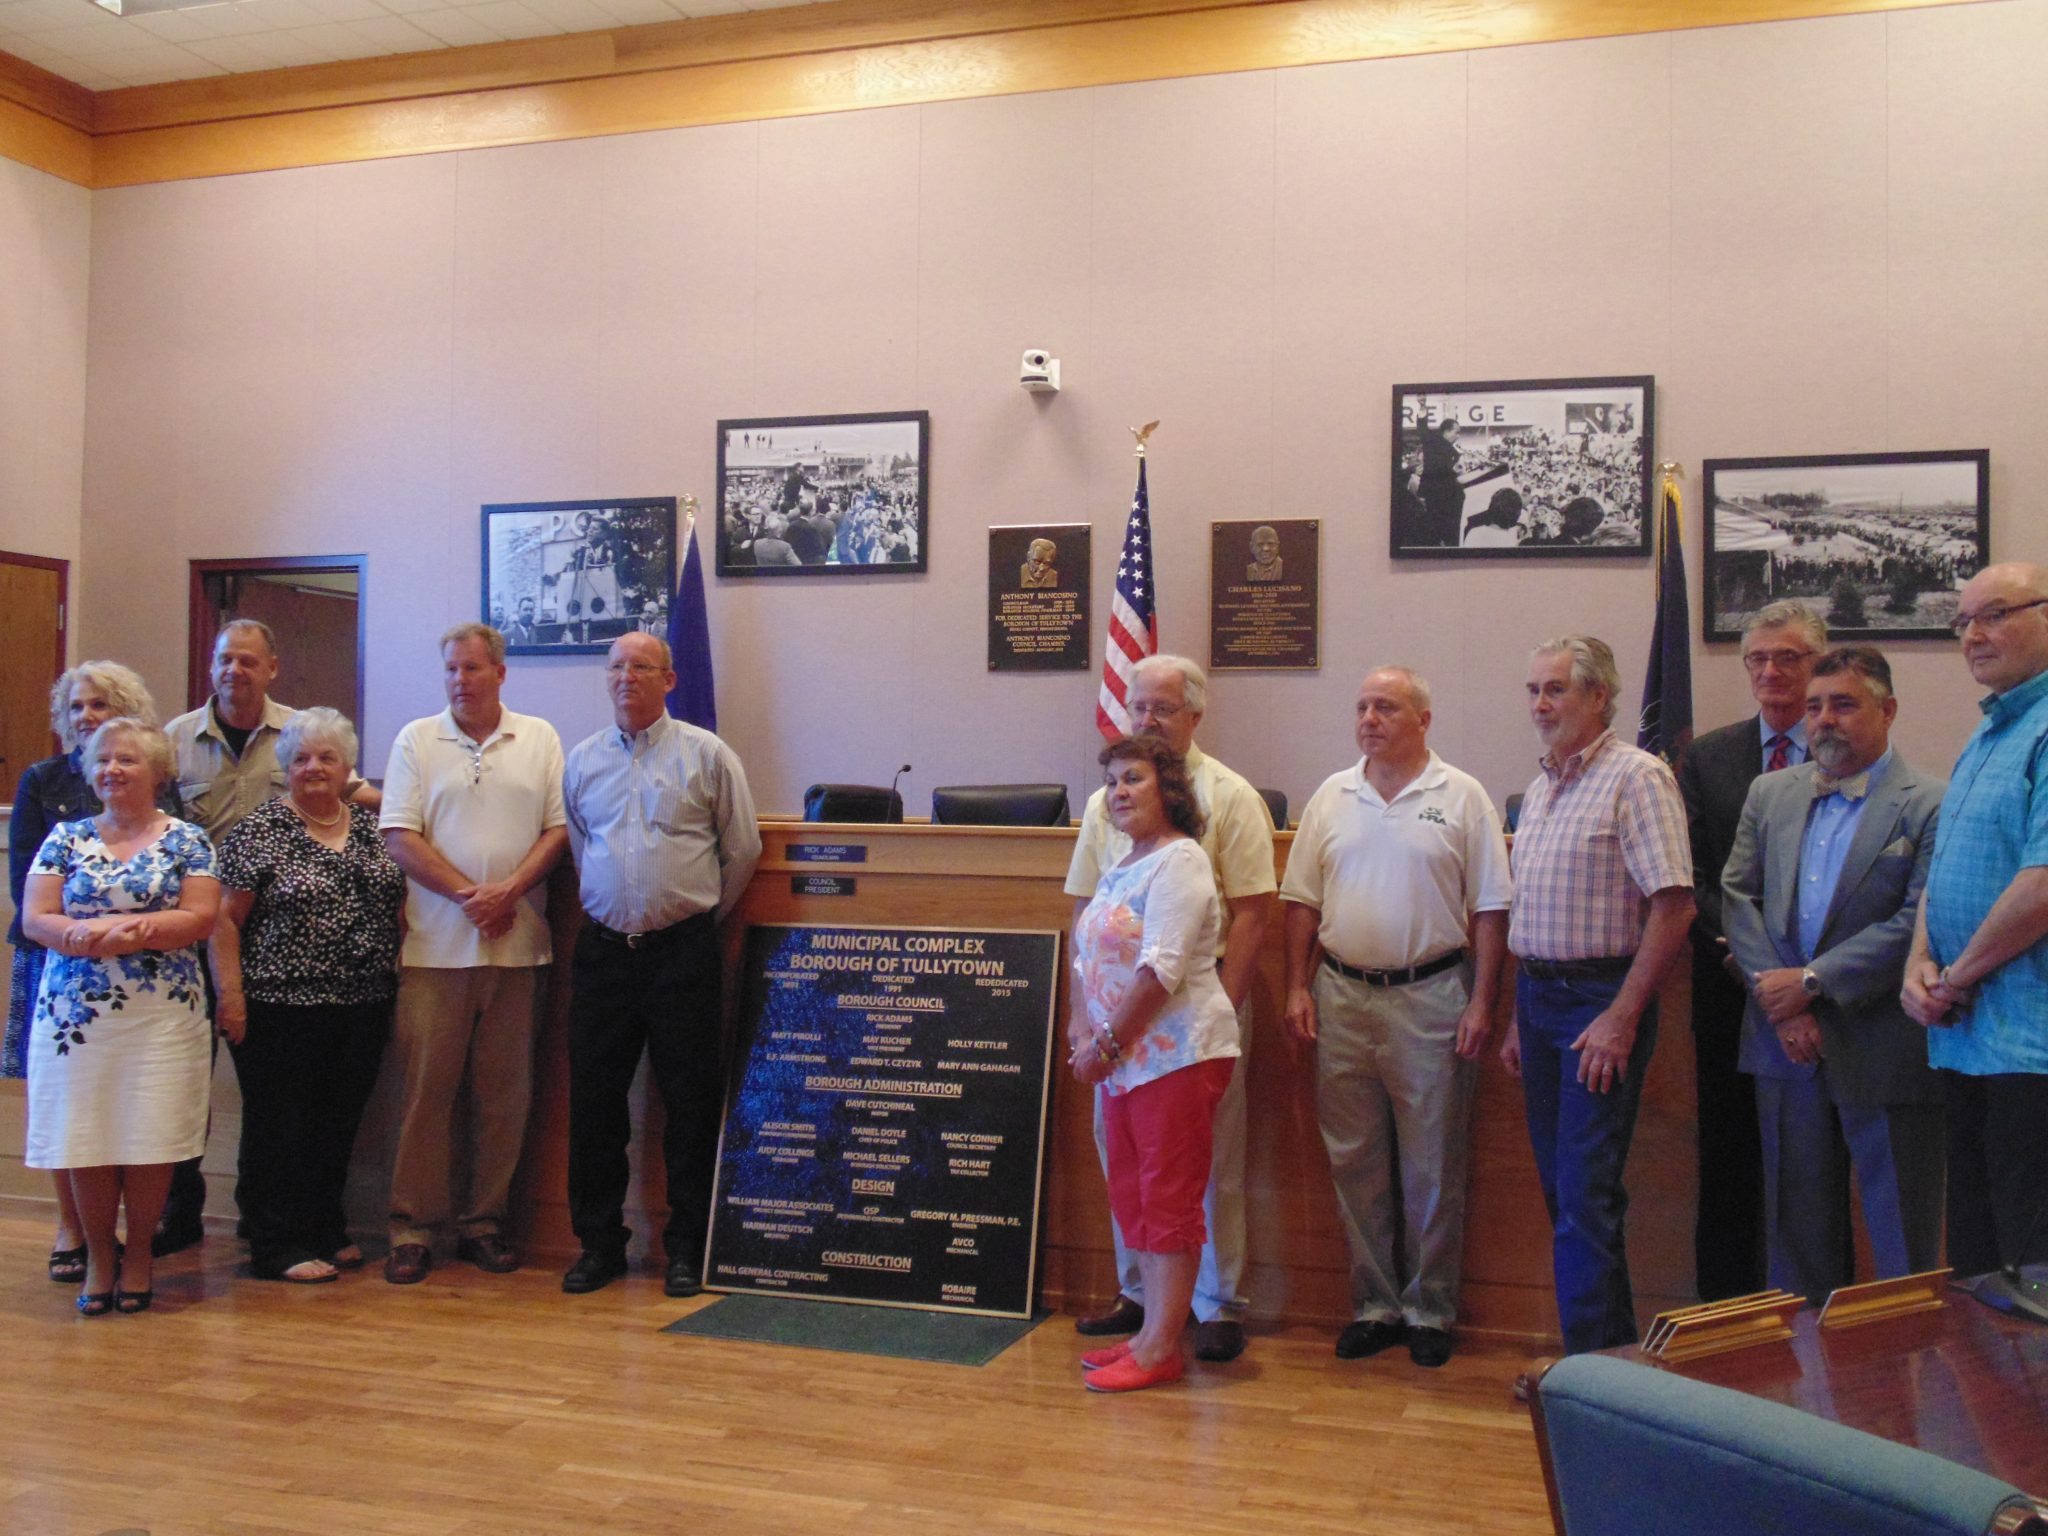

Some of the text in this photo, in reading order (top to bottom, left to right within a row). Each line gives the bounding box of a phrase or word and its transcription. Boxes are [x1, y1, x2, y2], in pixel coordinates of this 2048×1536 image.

[809, 878, 836, 886] COUNCIL
[805, 886, 840, 894] PRESIDENT
[811, 934, 985, 954] MUNICIPAL COMPLEX
[790, 954, 1005, 976] BOROUGH OF TULLYTOWN
[872, 975, 915, 984] DEDICATED
[975, 978, 1029, 988] REDEDICATED
[991, 989, 1011, 997] 2015
[837, 994, 946, 1009] BOROUGH COUNCIL
[886, 1015, 913, 1023] ADAMS
[862, 1036, 880, 1044] MAY
[947, 1039, 1008, 1050] HOLLY KETTLER
[850, 1057, 883, 1066] EDWARD
[937, 1061, 1021, 1073] MARY ANN GAHAGAN
[805, 1076, 963, 1095] BOROUGH ADMINISTRATION
[845, 1100, 866, 1108] DAVE
[851, 1127, 907, 1138] DANIEL DOYLE
[940, 1132, 1004, 1144] NANCY CONNER
[842, 1152, 911, 1164] MICHAEL SELLERS
[949, 1159, 991, 1169] RICH HART
[852, 1179, 895, 1192] DESIGN
[727, 1196, 834, 1212] WILLIAM MAJOR ASSOCIATES
[911, 1210, 1021, 1227] GREGORY M. PRESSMAN, P.E.
[777, 1223, 814, 1234] DEUTSCH
[952, 1238, 975, 1247] AVCO
[821, 1251, 912, 1269] CONSTRUCTION
[717, 1264, 829, 1282] HALL GENERAL CONTRACTING
